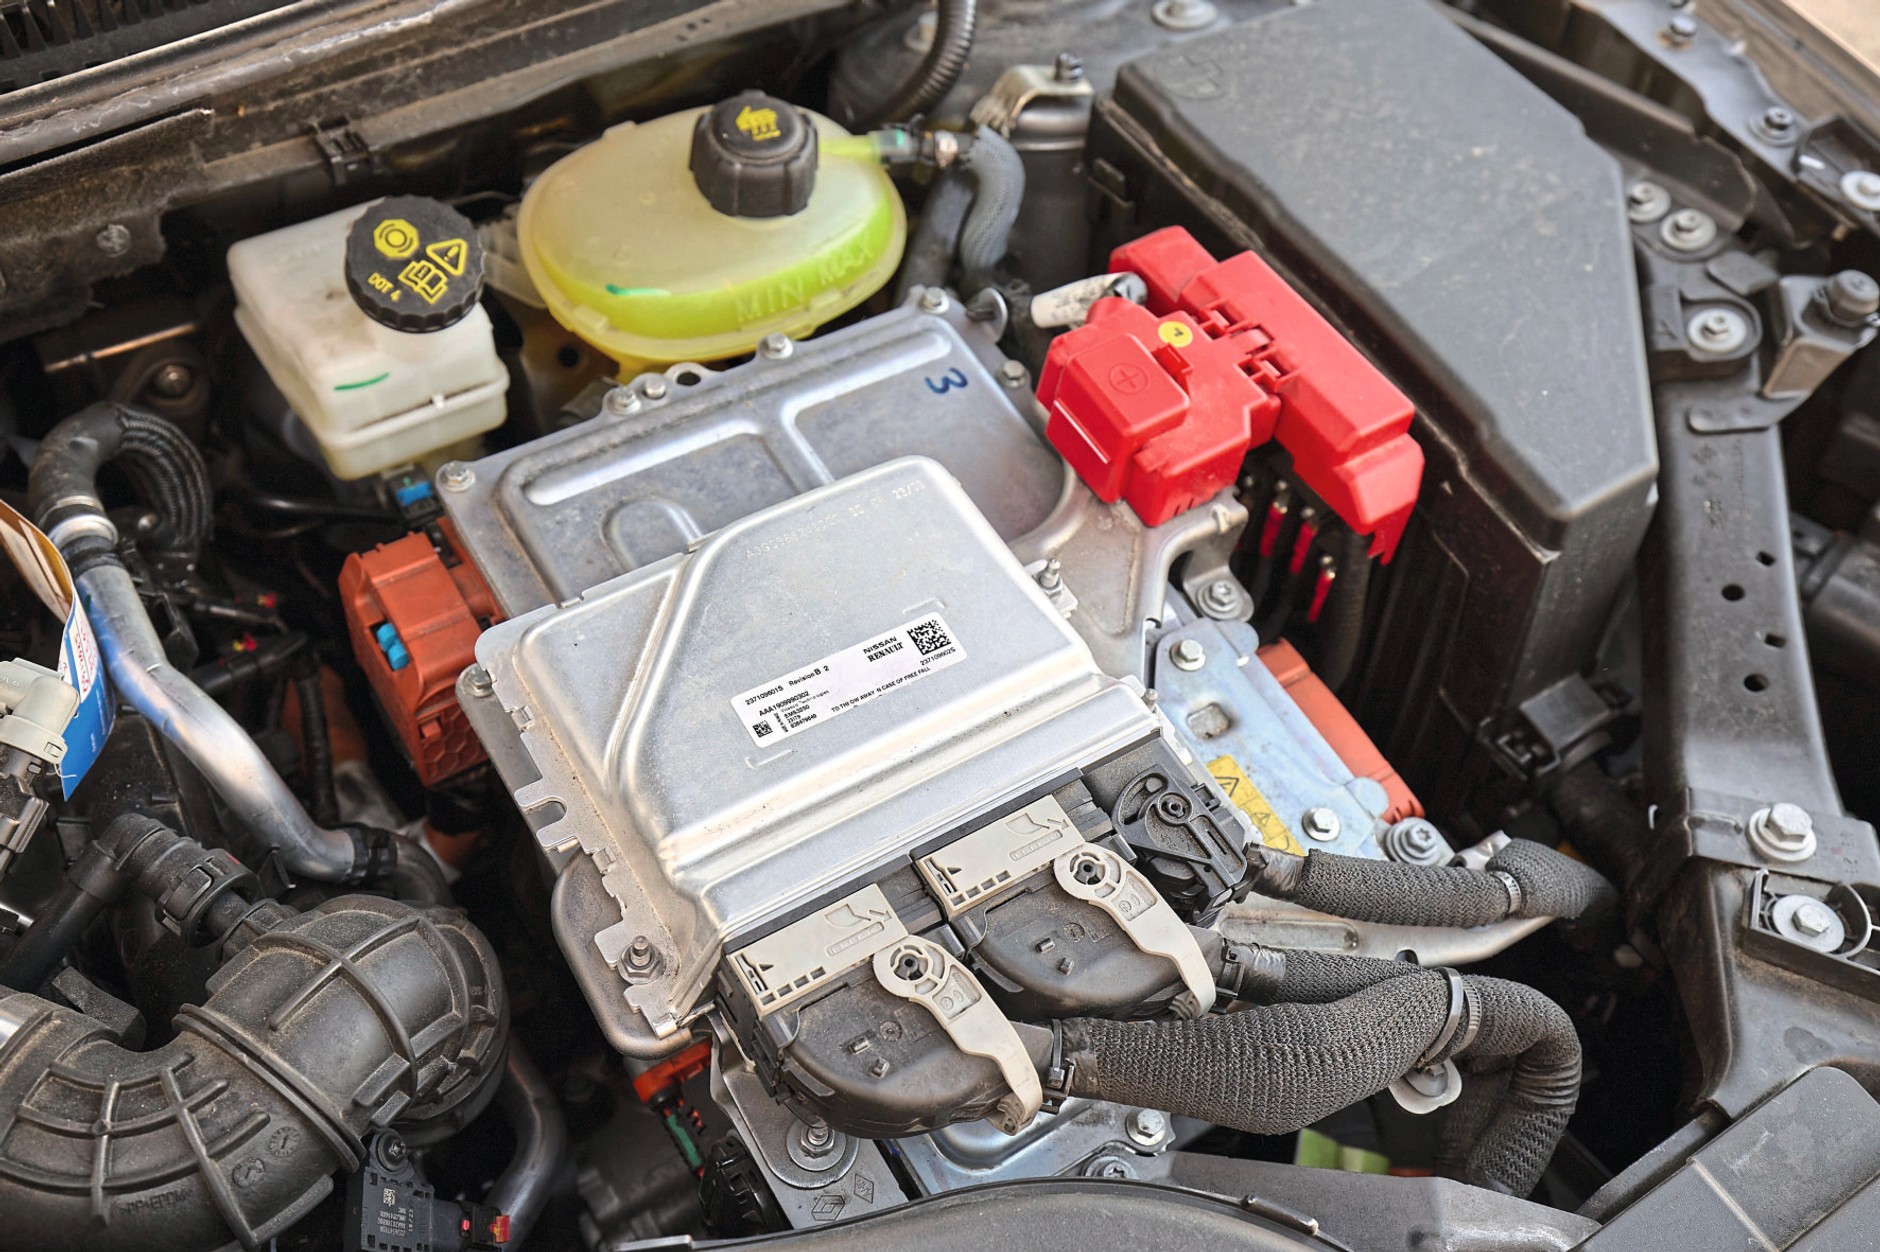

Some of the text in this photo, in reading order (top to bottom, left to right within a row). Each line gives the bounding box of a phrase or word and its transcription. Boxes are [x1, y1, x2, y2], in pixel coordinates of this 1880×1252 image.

[367, 272, 402, 302] DOT 4
[733, 276, 805, 323] MIN
[862, 635, 898, 655] NISSAN
[867, 642, 904, 663] RENAULT
[788, 671, 815, 687] Revision
[813, 667, 822, 676] B
[830, 705, 840, 713] TO
[860, 690, 876, 701] AWAY
[881, 680, 897, 691] CASE
[904, 671, 919, 681] FREE
[918, 666, 931, 675] FALL
